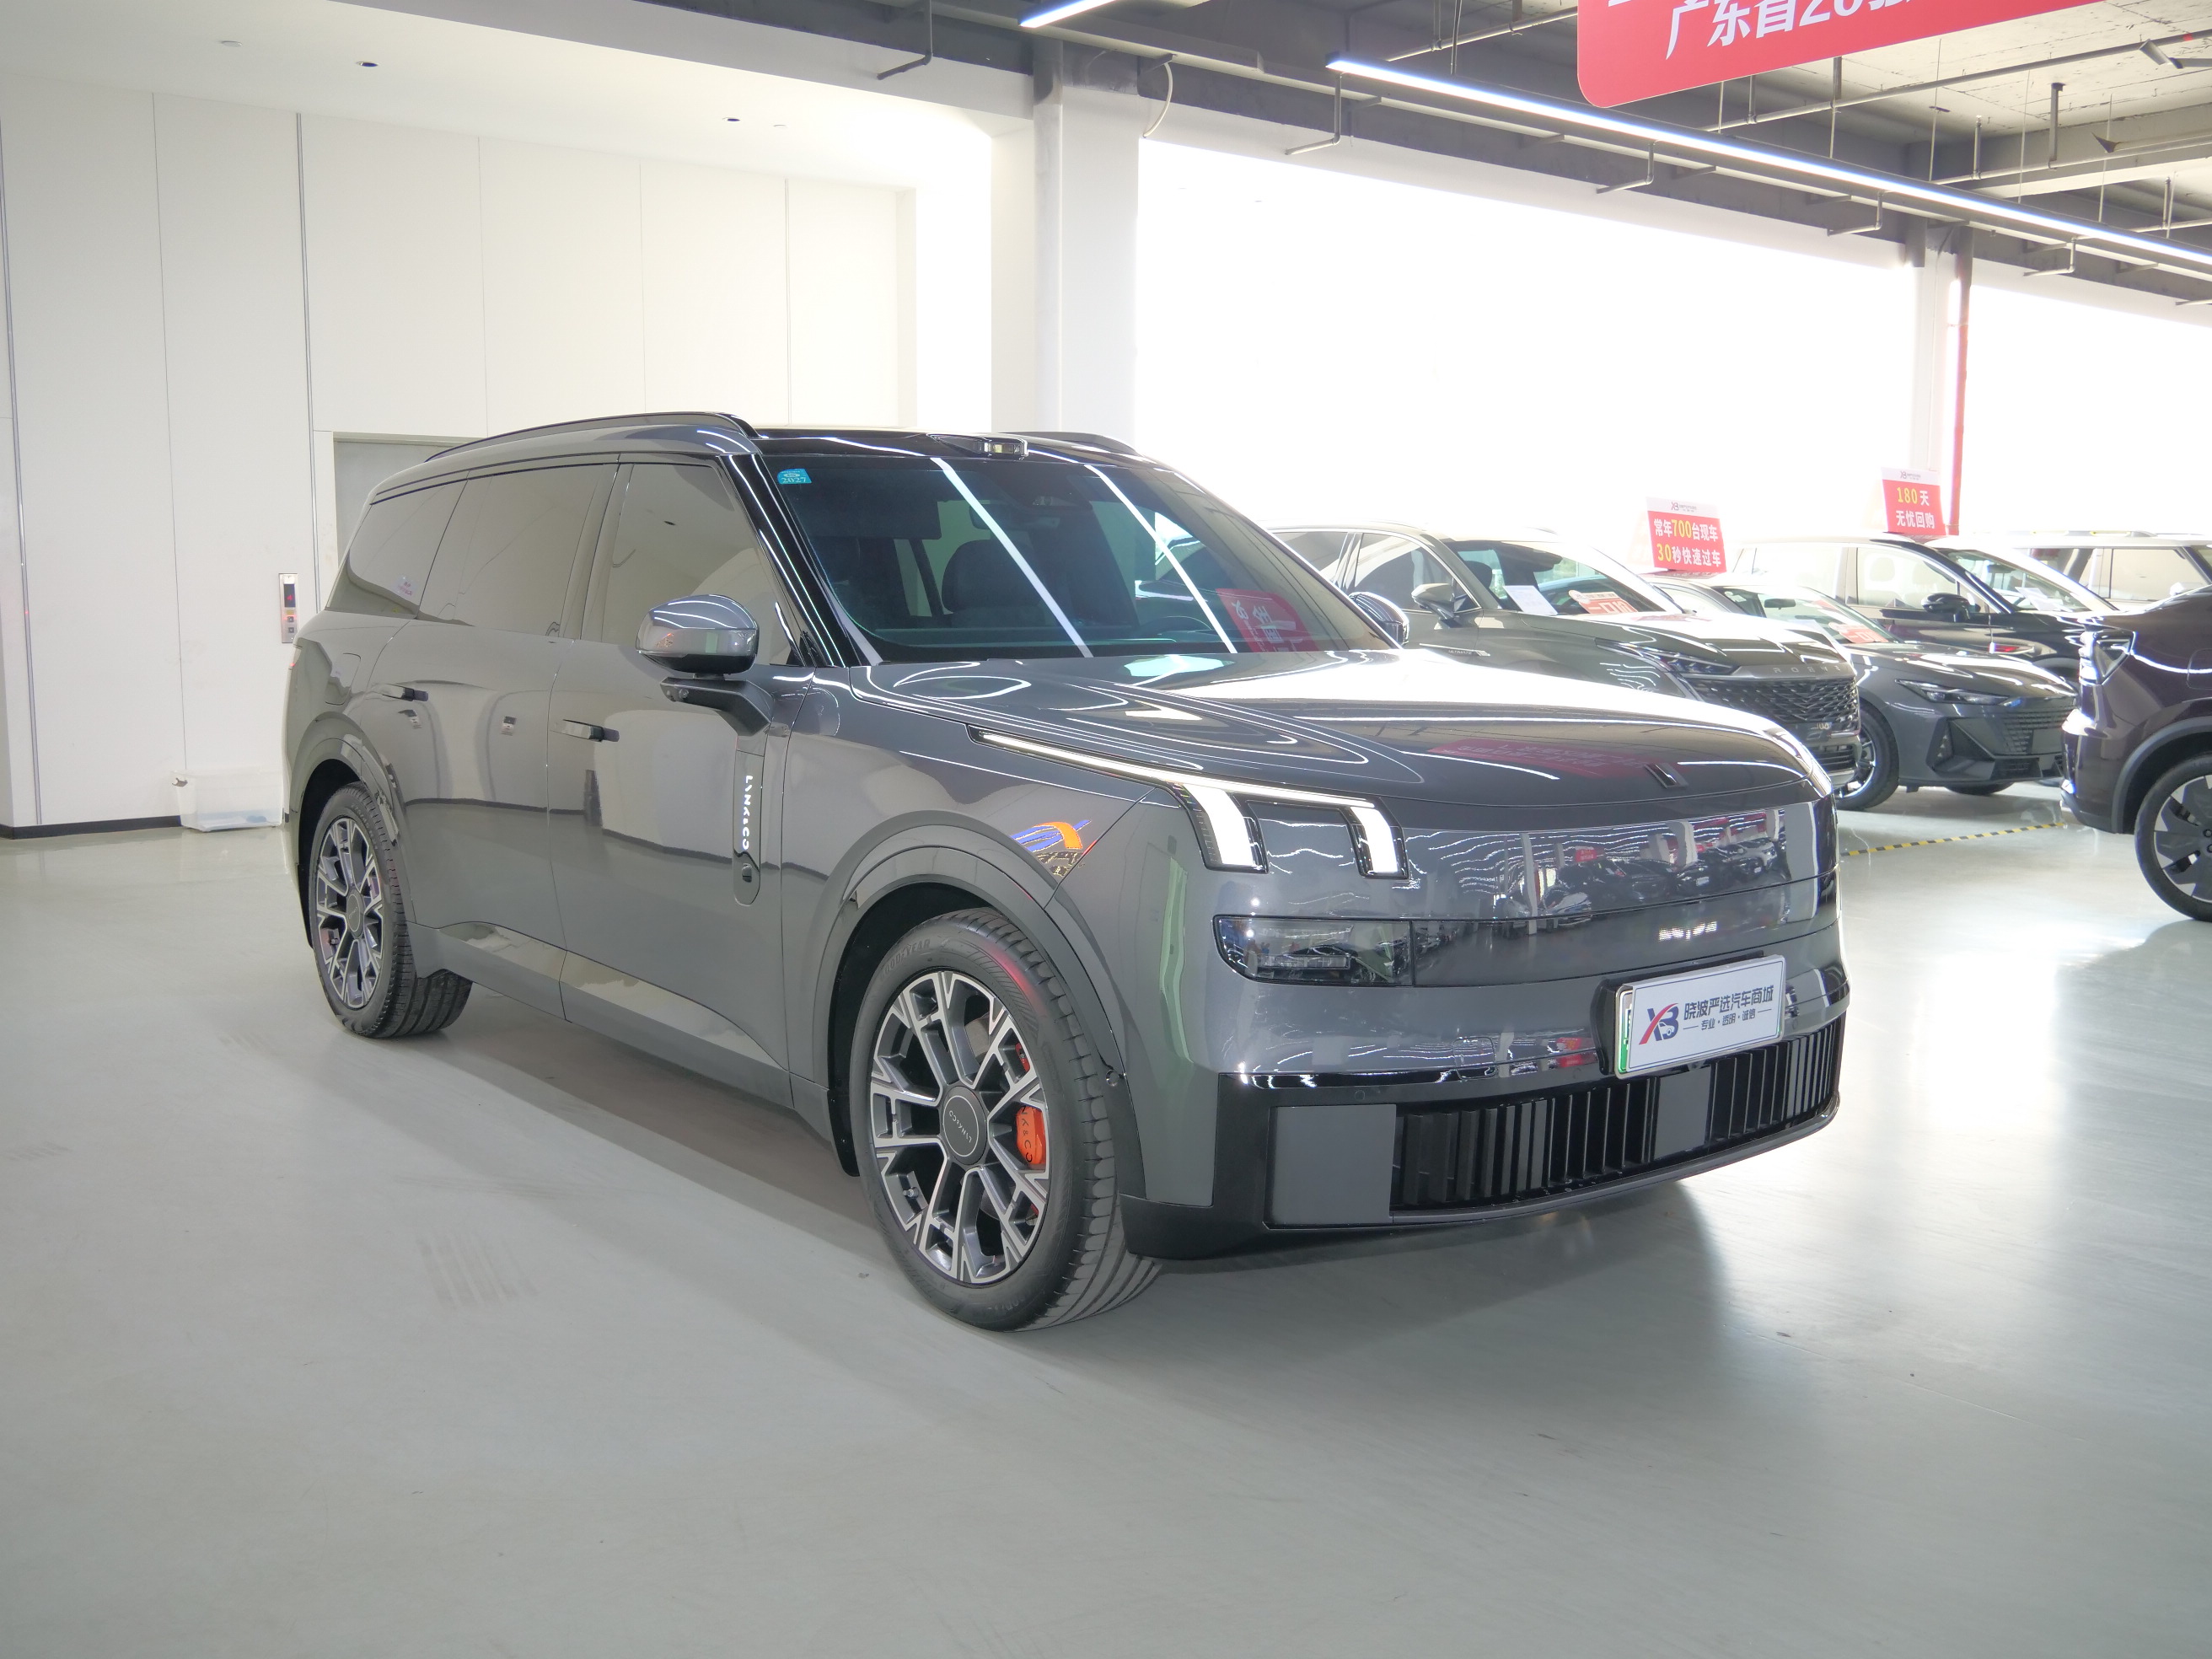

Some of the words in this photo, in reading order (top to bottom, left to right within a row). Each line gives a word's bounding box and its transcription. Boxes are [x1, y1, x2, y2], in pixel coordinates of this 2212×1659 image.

[1666, 0, 1910, 60] 广东首2
[1653, 518, 1719, 542] 常年700台现车
[1895, 510, 1935, 529] 无忧回购
[1656, 543, 1721, 567] 30秒快速过车
[1683, 985, 1774, 1020] 晓波严选汽车商城
